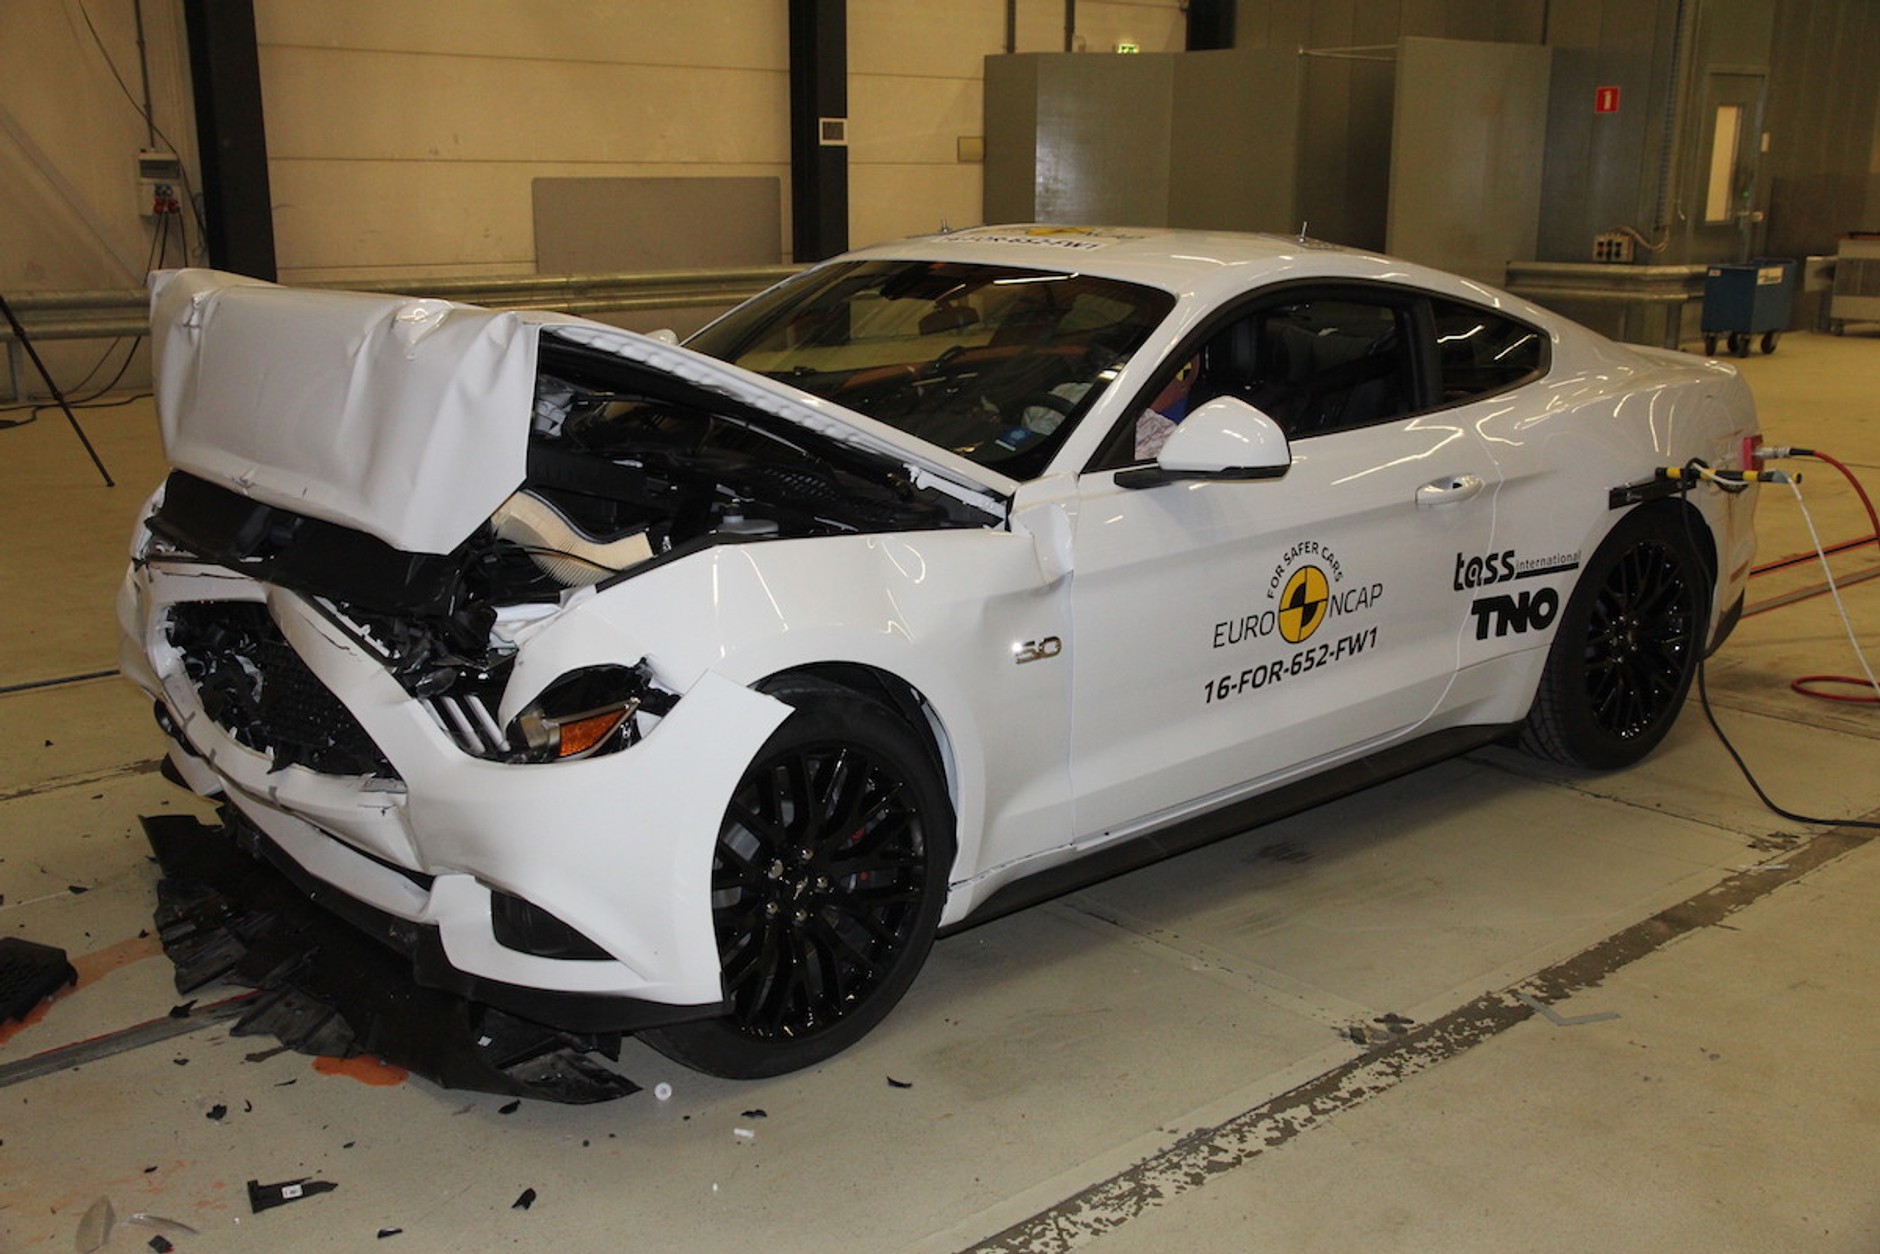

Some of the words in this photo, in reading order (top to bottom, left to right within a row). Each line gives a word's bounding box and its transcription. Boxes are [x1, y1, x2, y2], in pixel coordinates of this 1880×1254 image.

[1604, 91, 1611, 109] 1
[1267, 564, 1285, 599] FOR
[1283, 541, 1319, 567] SAFER
[1321, 546, 1344, 583] CARS
[1213, 610, 1276, 648] EURO
[1329, 583, 1383, 617] NCAP
[1471, 587, 1559, 640] TNO
[1204, 626, 1378, 704] 16-FOR-652-FW1
